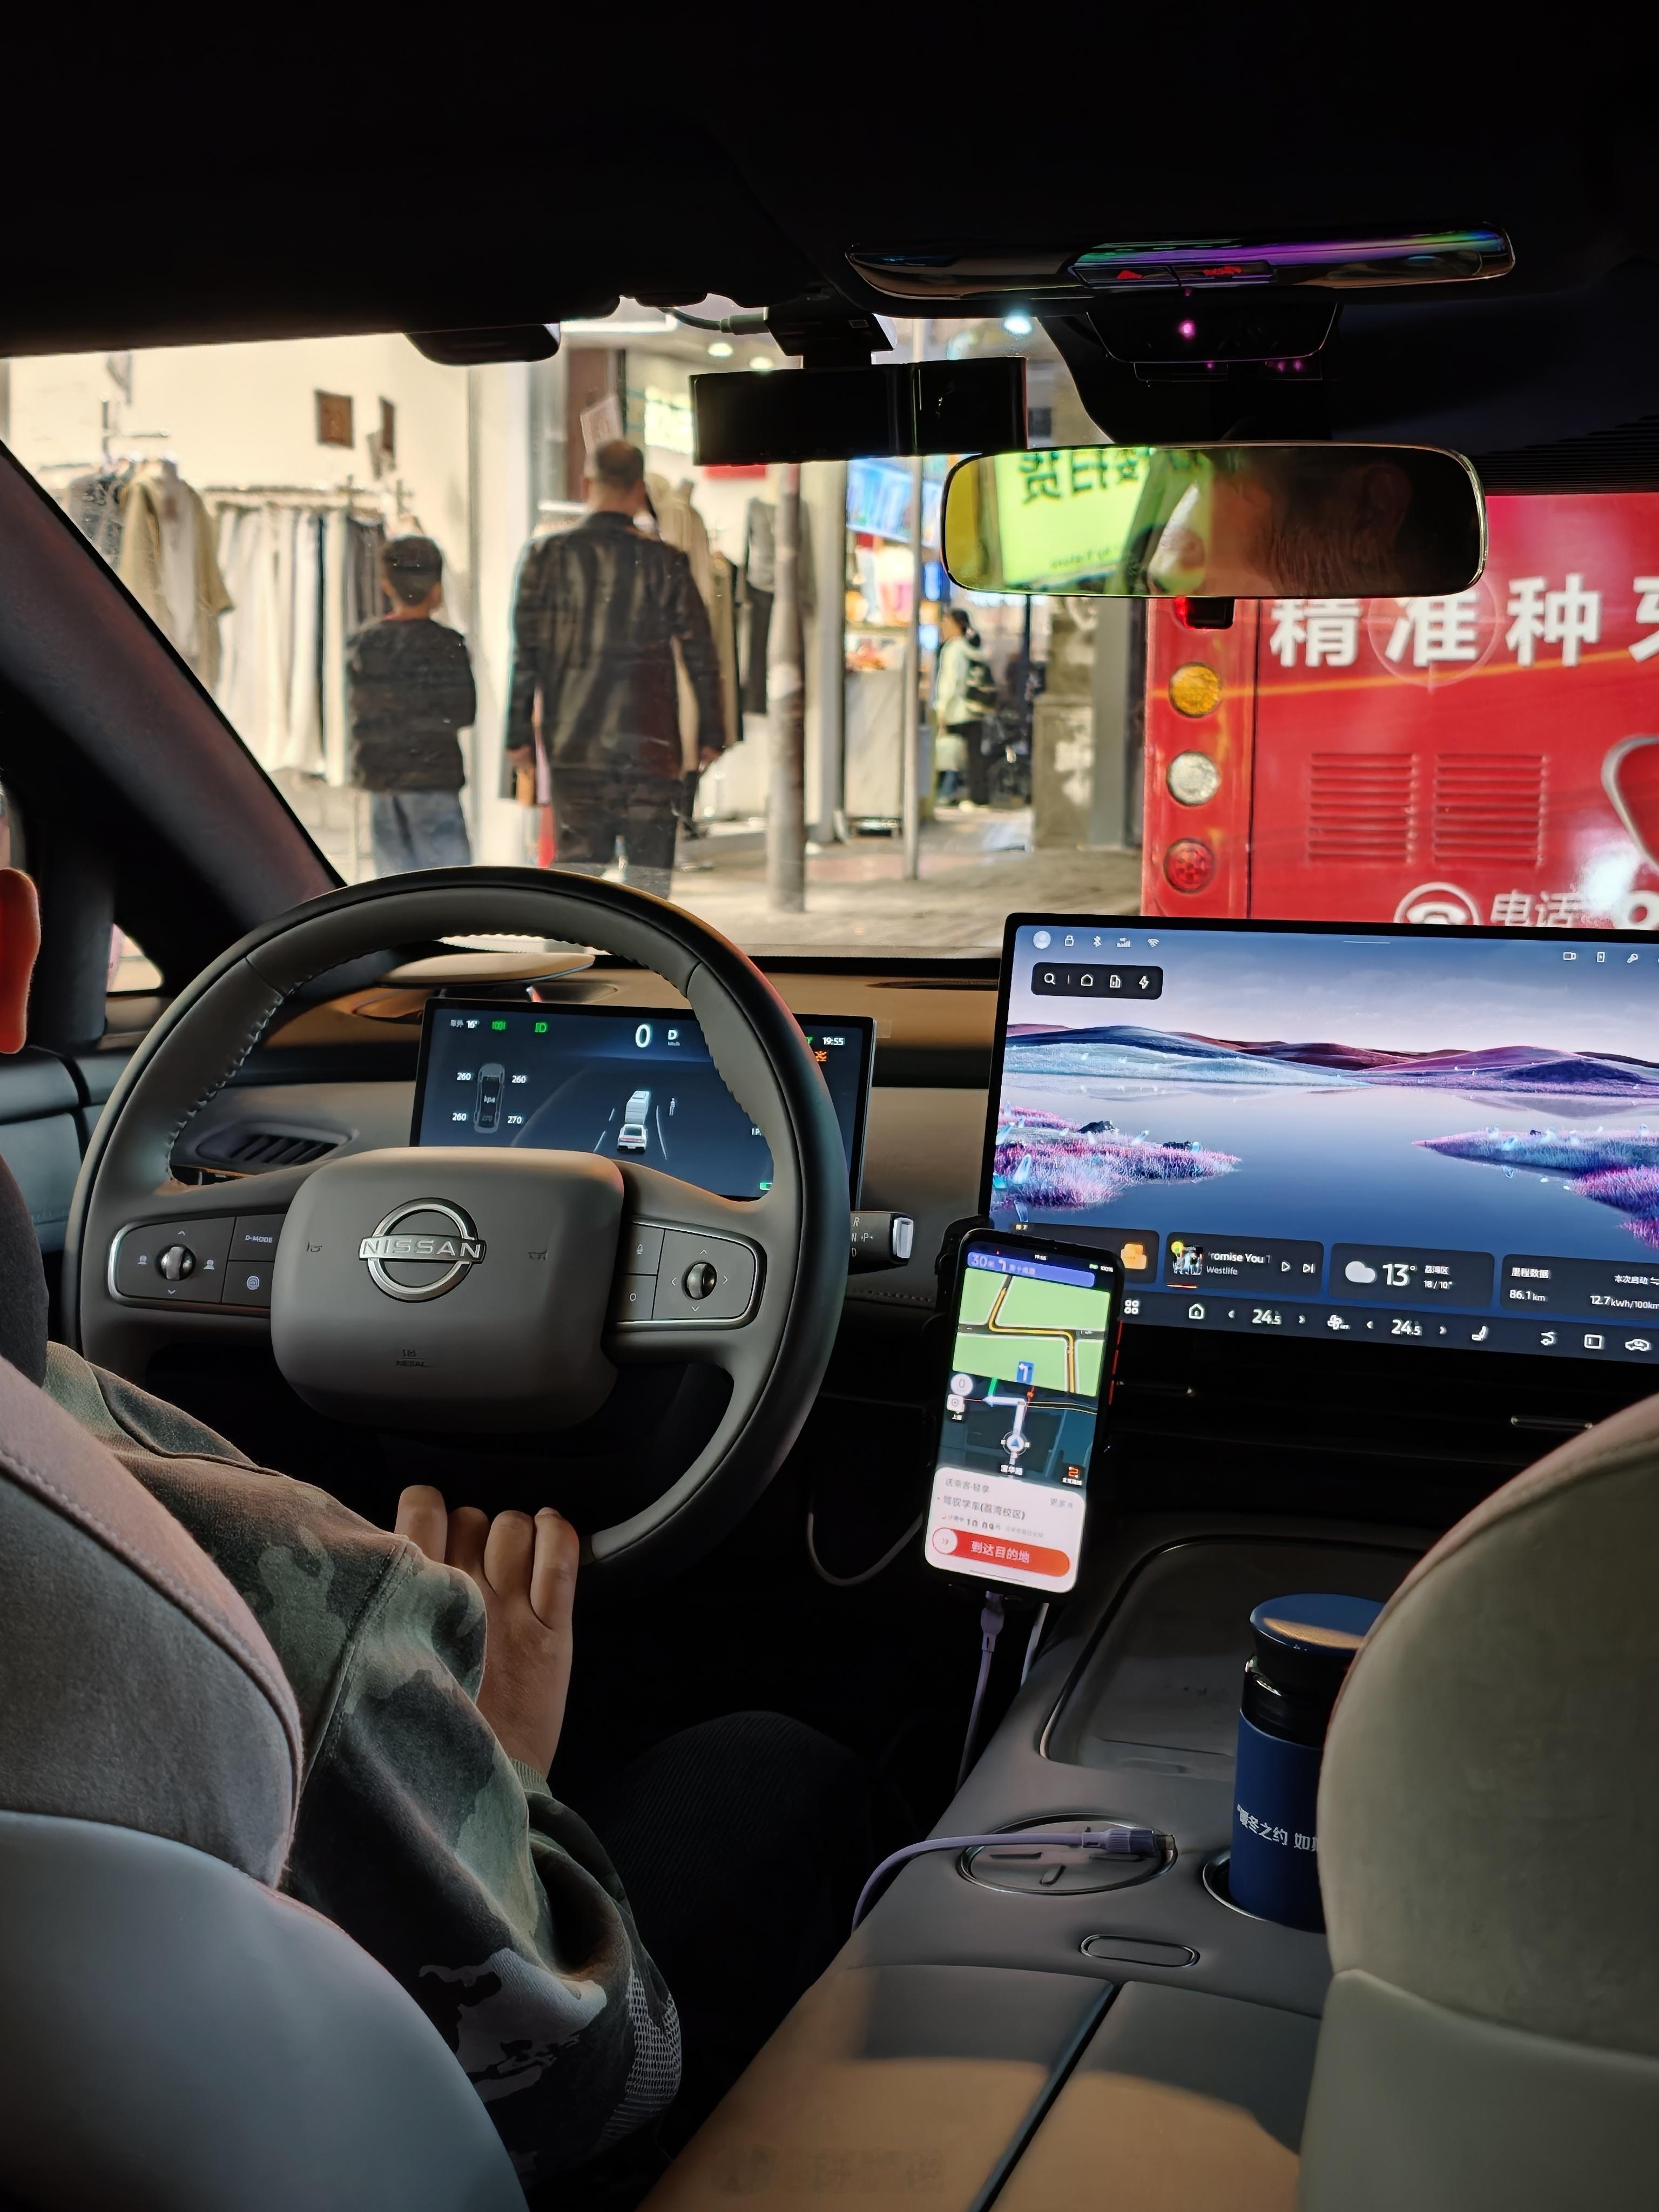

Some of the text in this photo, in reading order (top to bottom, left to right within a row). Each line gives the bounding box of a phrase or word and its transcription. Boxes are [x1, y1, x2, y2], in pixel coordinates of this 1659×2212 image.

[635, 1024, 678, 1048] 0 D
[822, 1037, 845, 1046] 19:55
[511, 1075, 527, 1083] 260
[452, 1112, 522, 1124] 260 270
[853, 1217, 860, 1227] R
[851, 1232, 857, 1243] N
[362, 1239, 481, 1258] NISSAN
[851, 1247, 857, 1257] D
[1209, 1251, 1243, 1262] romise
[1244, 1253, 1264, 1263] You
[1206, 1266, 1238, 1276] Westlife
[1382, 1264, 1416, 1286] 13°
[1614, 1274, 1648, 1285] 本次启动
[970, 1540, 1030, 1563] 到达目的地
